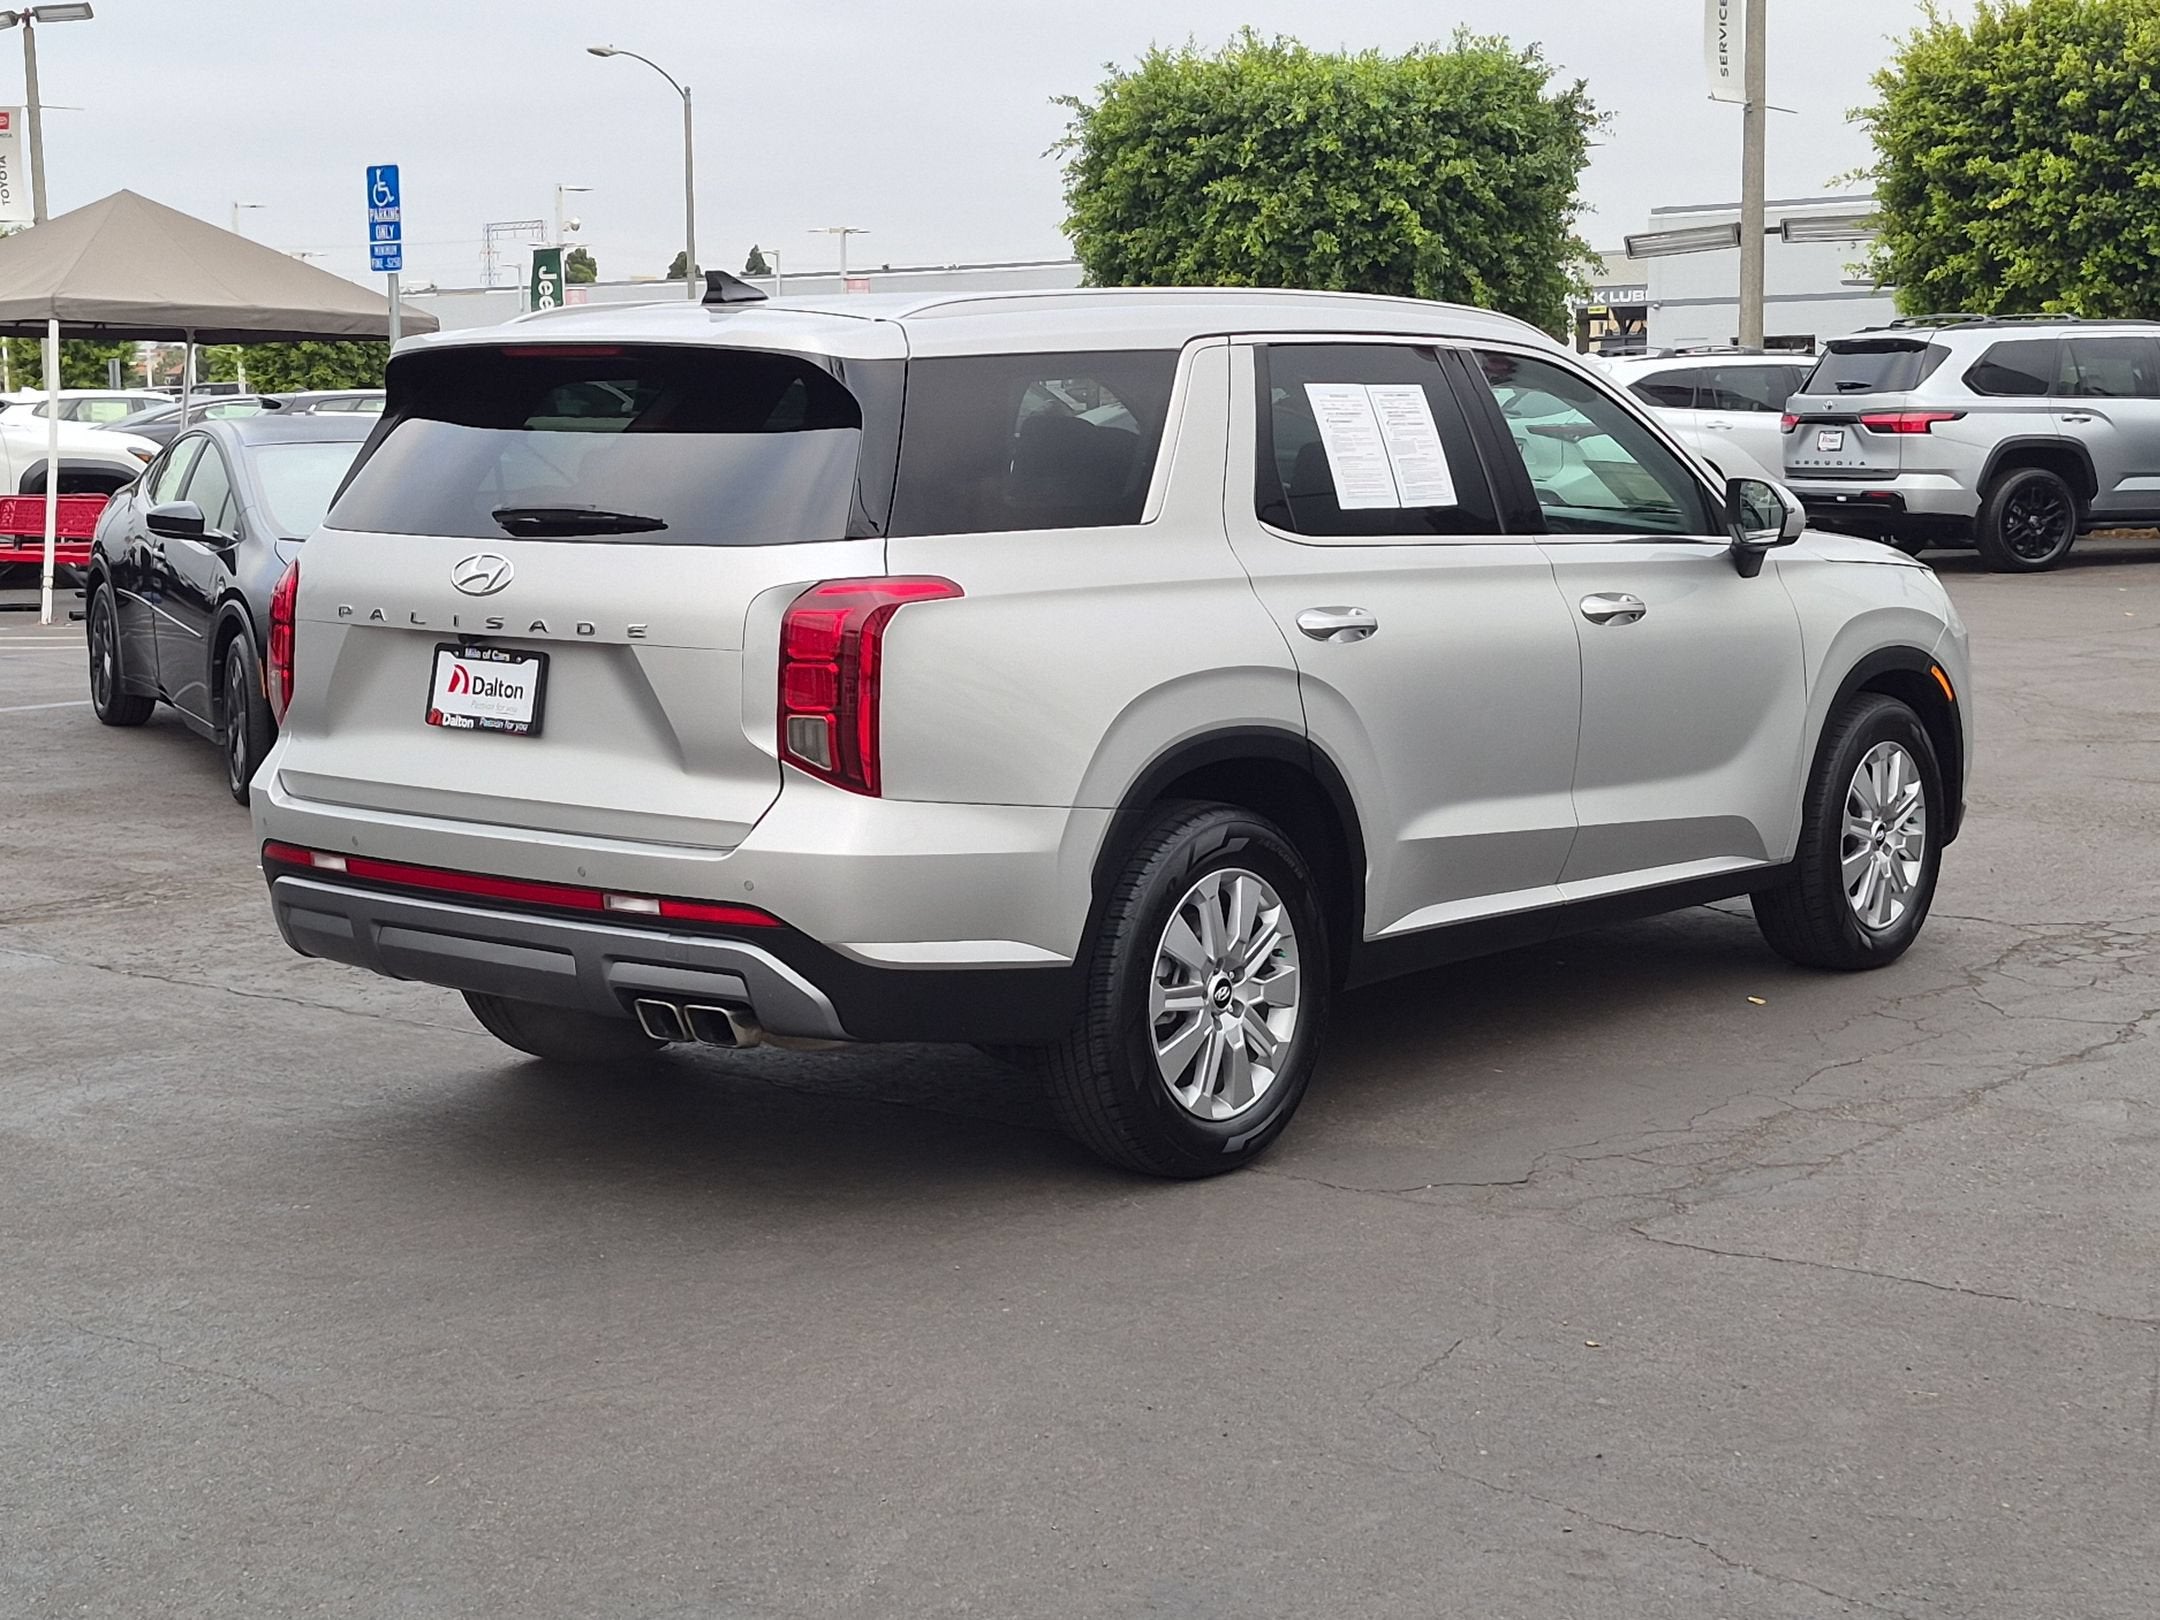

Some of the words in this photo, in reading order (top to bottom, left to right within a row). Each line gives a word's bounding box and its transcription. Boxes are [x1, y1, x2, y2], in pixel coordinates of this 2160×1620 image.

[1719, 0, 1729, 77] SERVICE
[369, 207, 400, 223] PARKING
[376, 224, 395, 240] ONLY
[538, 265, 558, 310] Jee
[1609, 290, 1648, 303] LUB
[338, 605, 648, 640] PALISADE
[472, 675, 524, 700] Dalton
[442, 713, 474, 728] Dalton
